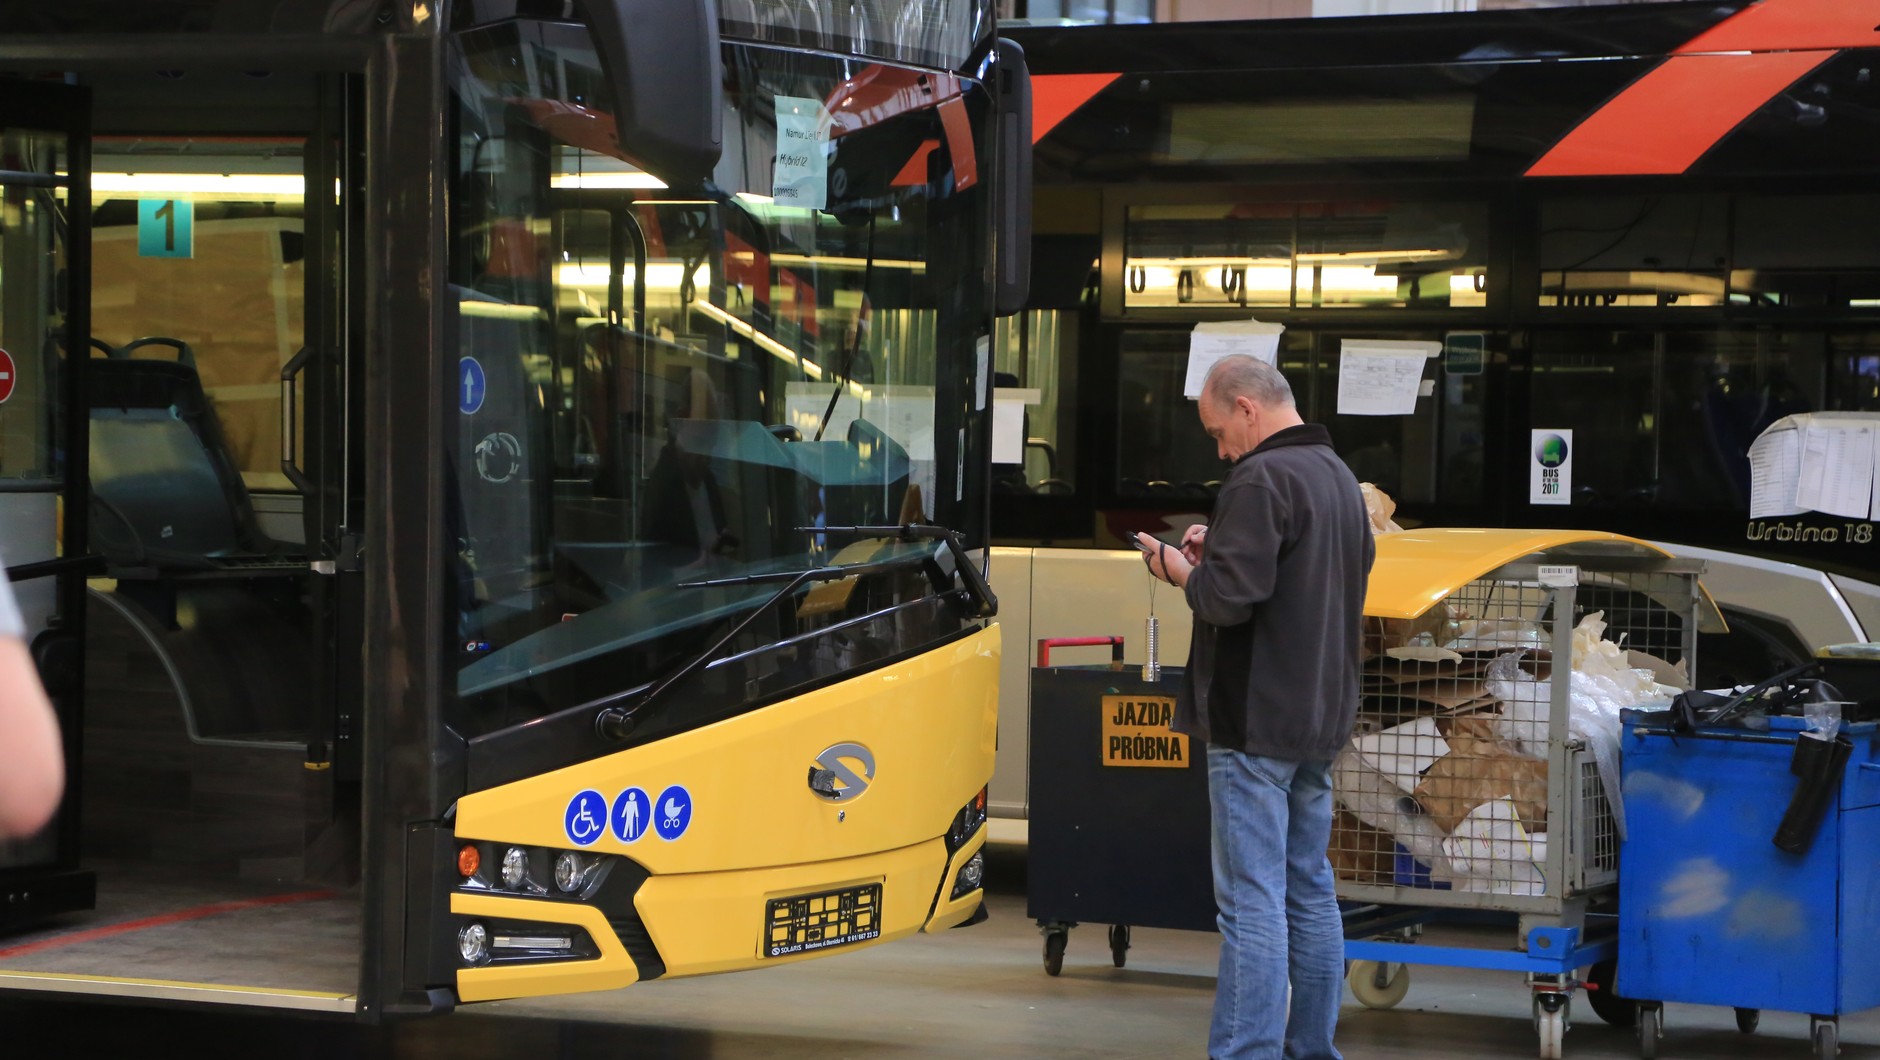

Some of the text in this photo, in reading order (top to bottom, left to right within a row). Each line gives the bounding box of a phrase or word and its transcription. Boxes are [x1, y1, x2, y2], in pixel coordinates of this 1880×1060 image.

[786, 128, 804, 139] Namur
[779, 153, 800, 168] Hybrid
[155, 199, 175, 251] 1
[1543, 469, 1559, 477] BUS
[1543, 483, 1559, 494] 2017
[1746, 522, 1873, 543] Urbino 18
[1112, 702, 1171, 726] JAZDA
[1109, 732, 1182, 761] PRÓBNA
[780, 945, 802, 954] SOLARIS
